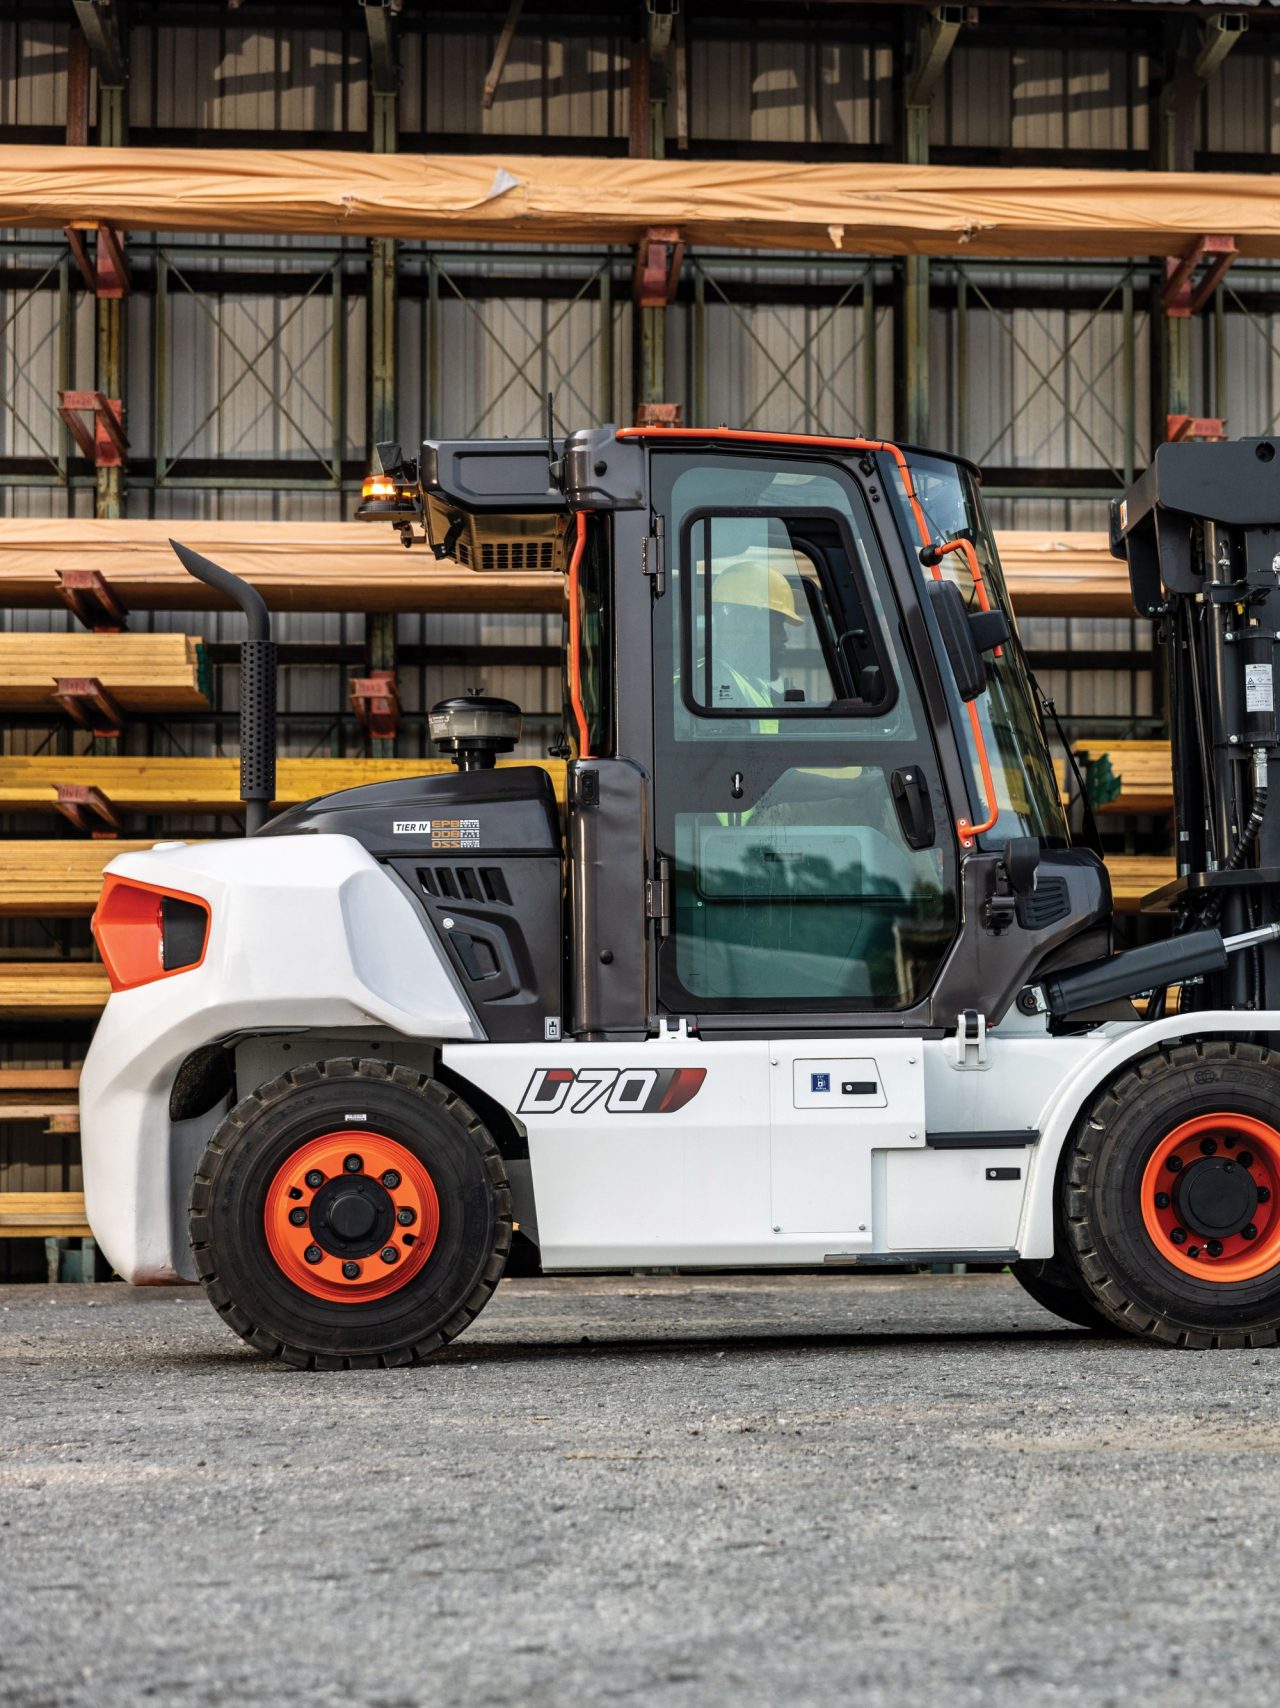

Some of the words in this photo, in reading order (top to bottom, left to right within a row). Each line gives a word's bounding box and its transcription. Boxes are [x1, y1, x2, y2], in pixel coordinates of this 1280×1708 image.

[396, 823, 416, 832] TIER
[419, 823, 427, 832] IV
[516, 1067, 658, 1114] D70
